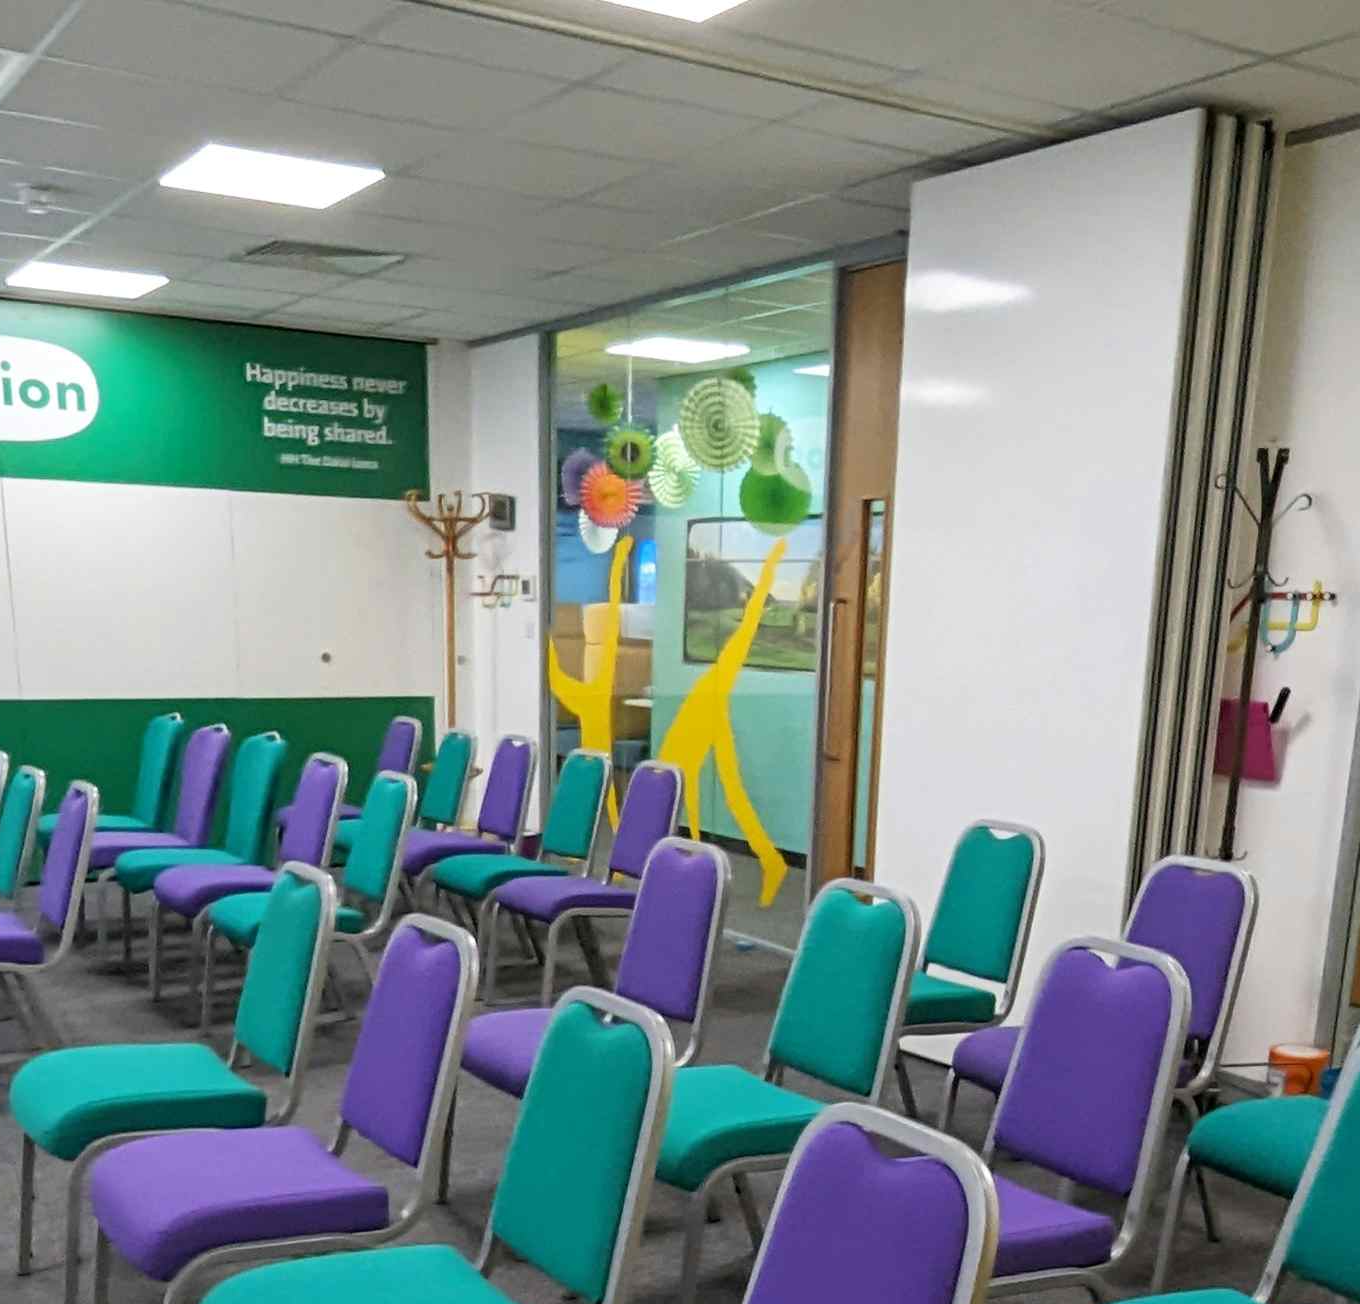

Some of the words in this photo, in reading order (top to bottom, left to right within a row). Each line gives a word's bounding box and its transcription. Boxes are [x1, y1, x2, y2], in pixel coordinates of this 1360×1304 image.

[245, 362, 348, 391] Happiness
[351, 376, 407, 394] never
[263, 390, 359, 416] decreases
[363, 398, 386, 424] by
[263, 416, 320, 446] being
[324, 422, 392, 445] shared.
